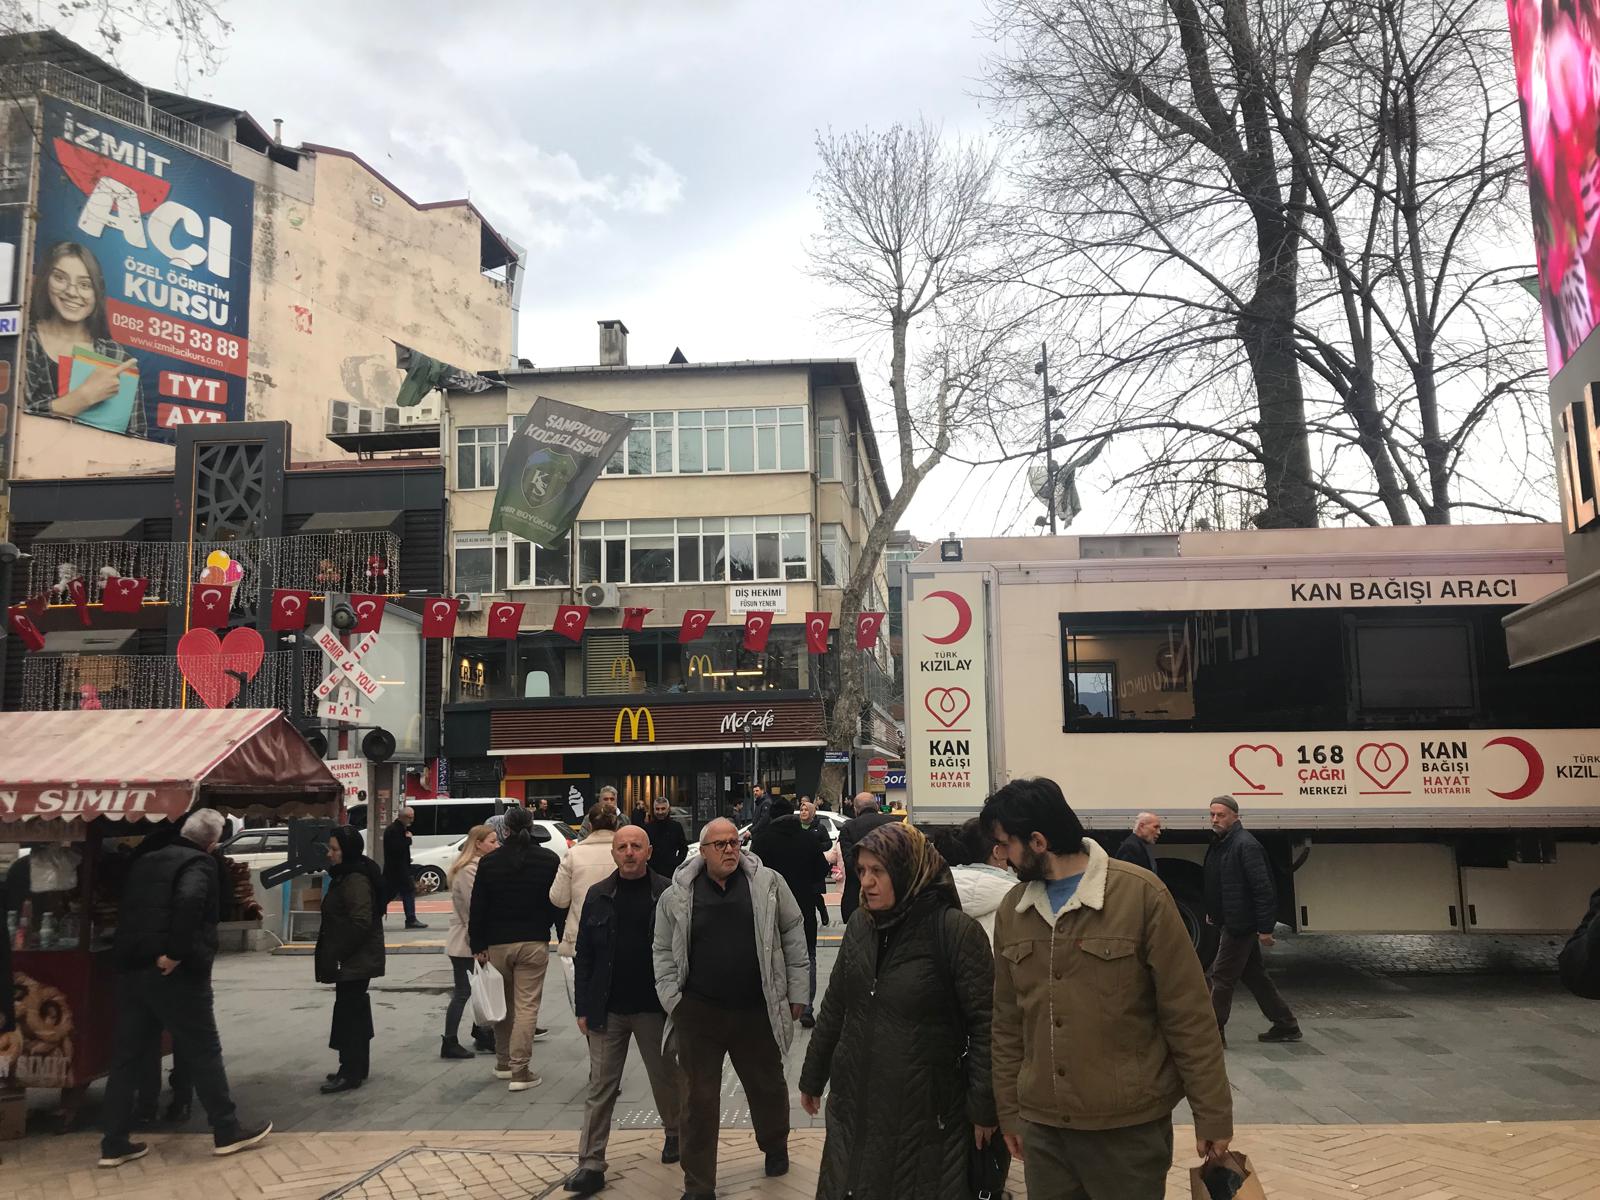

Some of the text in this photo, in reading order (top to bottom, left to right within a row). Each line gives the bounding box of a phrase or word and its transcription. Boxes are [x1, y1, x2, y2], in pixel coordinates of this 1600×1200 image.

[64, 112, 171, 177] İZMİT
[78, 176, 232, 278] AÇI
[124, 256, 230, 303] ÖZEL ÖĞRETİM
[124, 273, 229, 326] KURSU
[112, 313, 239, 359] 0262 325 33 88
[129, 335, 224, 367] www.izmitacikurs.com
[168, 374, 220, 401] TYT
[735, 588, 781, 598] DİŞ HEKİMİ
[1291, 577, 1517, 604] KAN BAĞIŞI ARACI
[320, 633, 344, 661] DEMİR
[920, 660, 972, 672] KIZILAY
[356, 671, 377, 694] YOLU
[344, 691, 350, 700] 1
[328, 705, 362, 718] HAT
[929, 740, 970, 756] KAN
[1297, 745, 1344, 764] 168
[1420, 742, 1468, 759] KAN
[330, 762, 362, 771] KIRMIZI
[929, 756, 970, 769] BAĞIŞI
[1573, 754, 1600, 763] TÜRK
[930, 772, 971, 780] HAYAT
[1297, 766, 1345, 784] ÇAĞRI
[1422, 761, 1469, 774] BAĞIŞI
[1556, 766, 1600, 778] KIZIL
[1423, 776, 1470, 786] HAYAT
[34, 782, 156, 813] SİMİT
[1299, 785, 1347, 795] MERKEZİ
